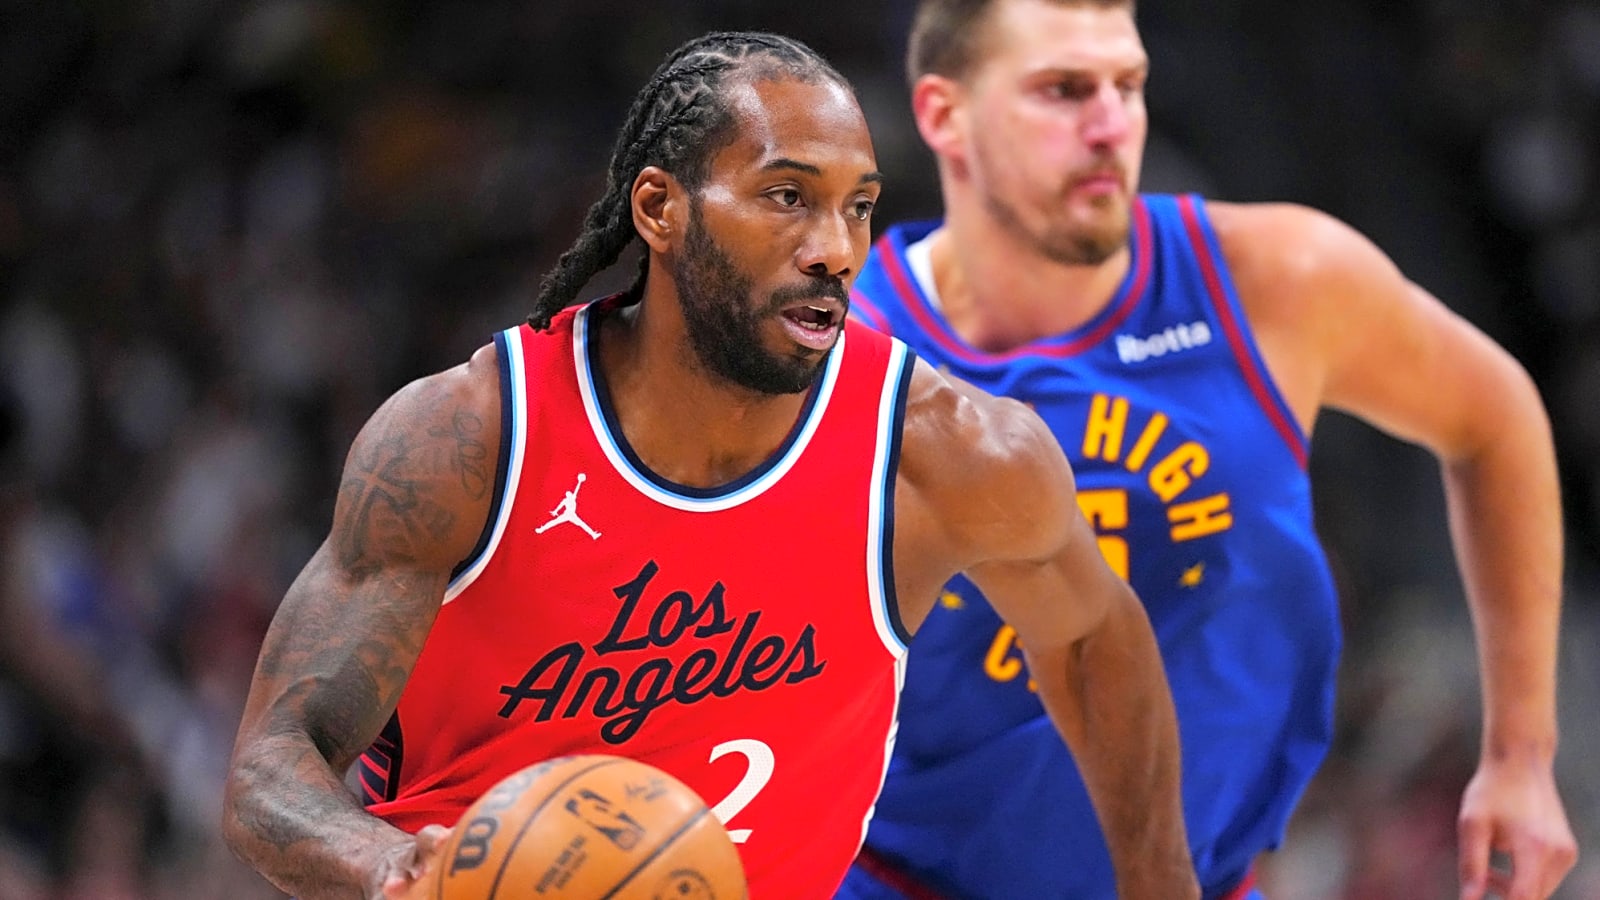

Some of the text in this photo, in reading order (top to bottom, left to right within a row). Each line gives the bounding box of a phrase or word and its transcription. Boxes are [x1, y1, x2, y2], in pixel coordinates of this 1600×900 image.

[1082, 393, 1233, 542] HIGH
[592, 560, 736, 655] Los
[498, 611, 826, 745] Angeles
[708, 738, 776, 844] 2
